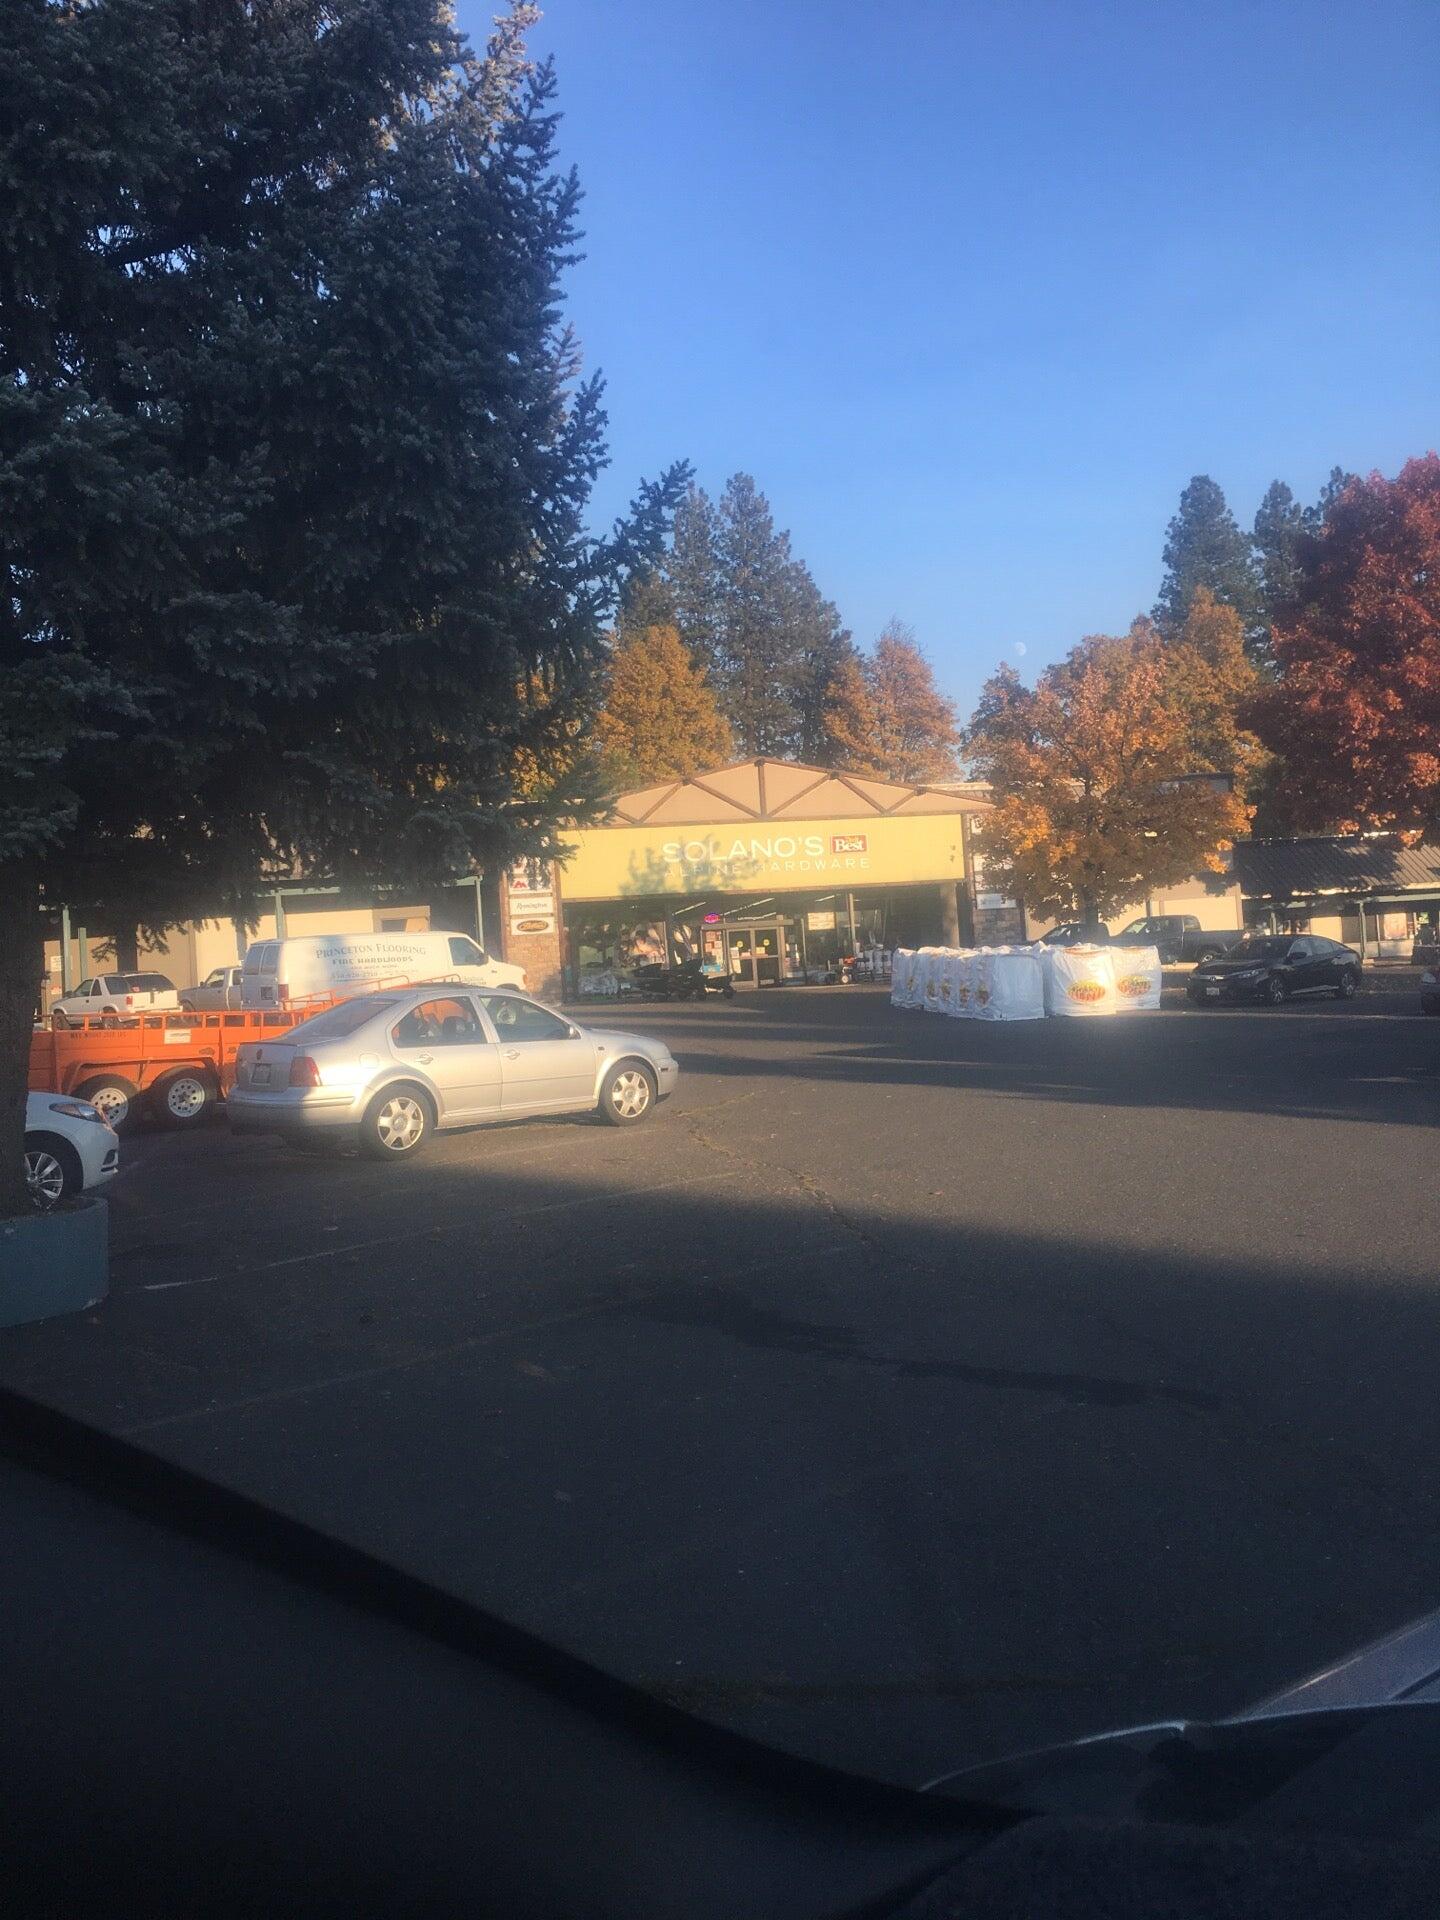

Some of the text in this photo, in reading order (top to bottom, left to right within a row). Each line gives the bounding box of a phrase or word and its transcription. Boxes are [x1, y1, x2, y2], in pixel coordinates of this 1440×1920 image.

[662, 836, 824, 863] SOLANO'S
[834, 838, 865, 852] Best
[664, 858, 871, 878] ALPINE HARDWARE
[316, 943, 426, 959] PRINCETON FLOORING
